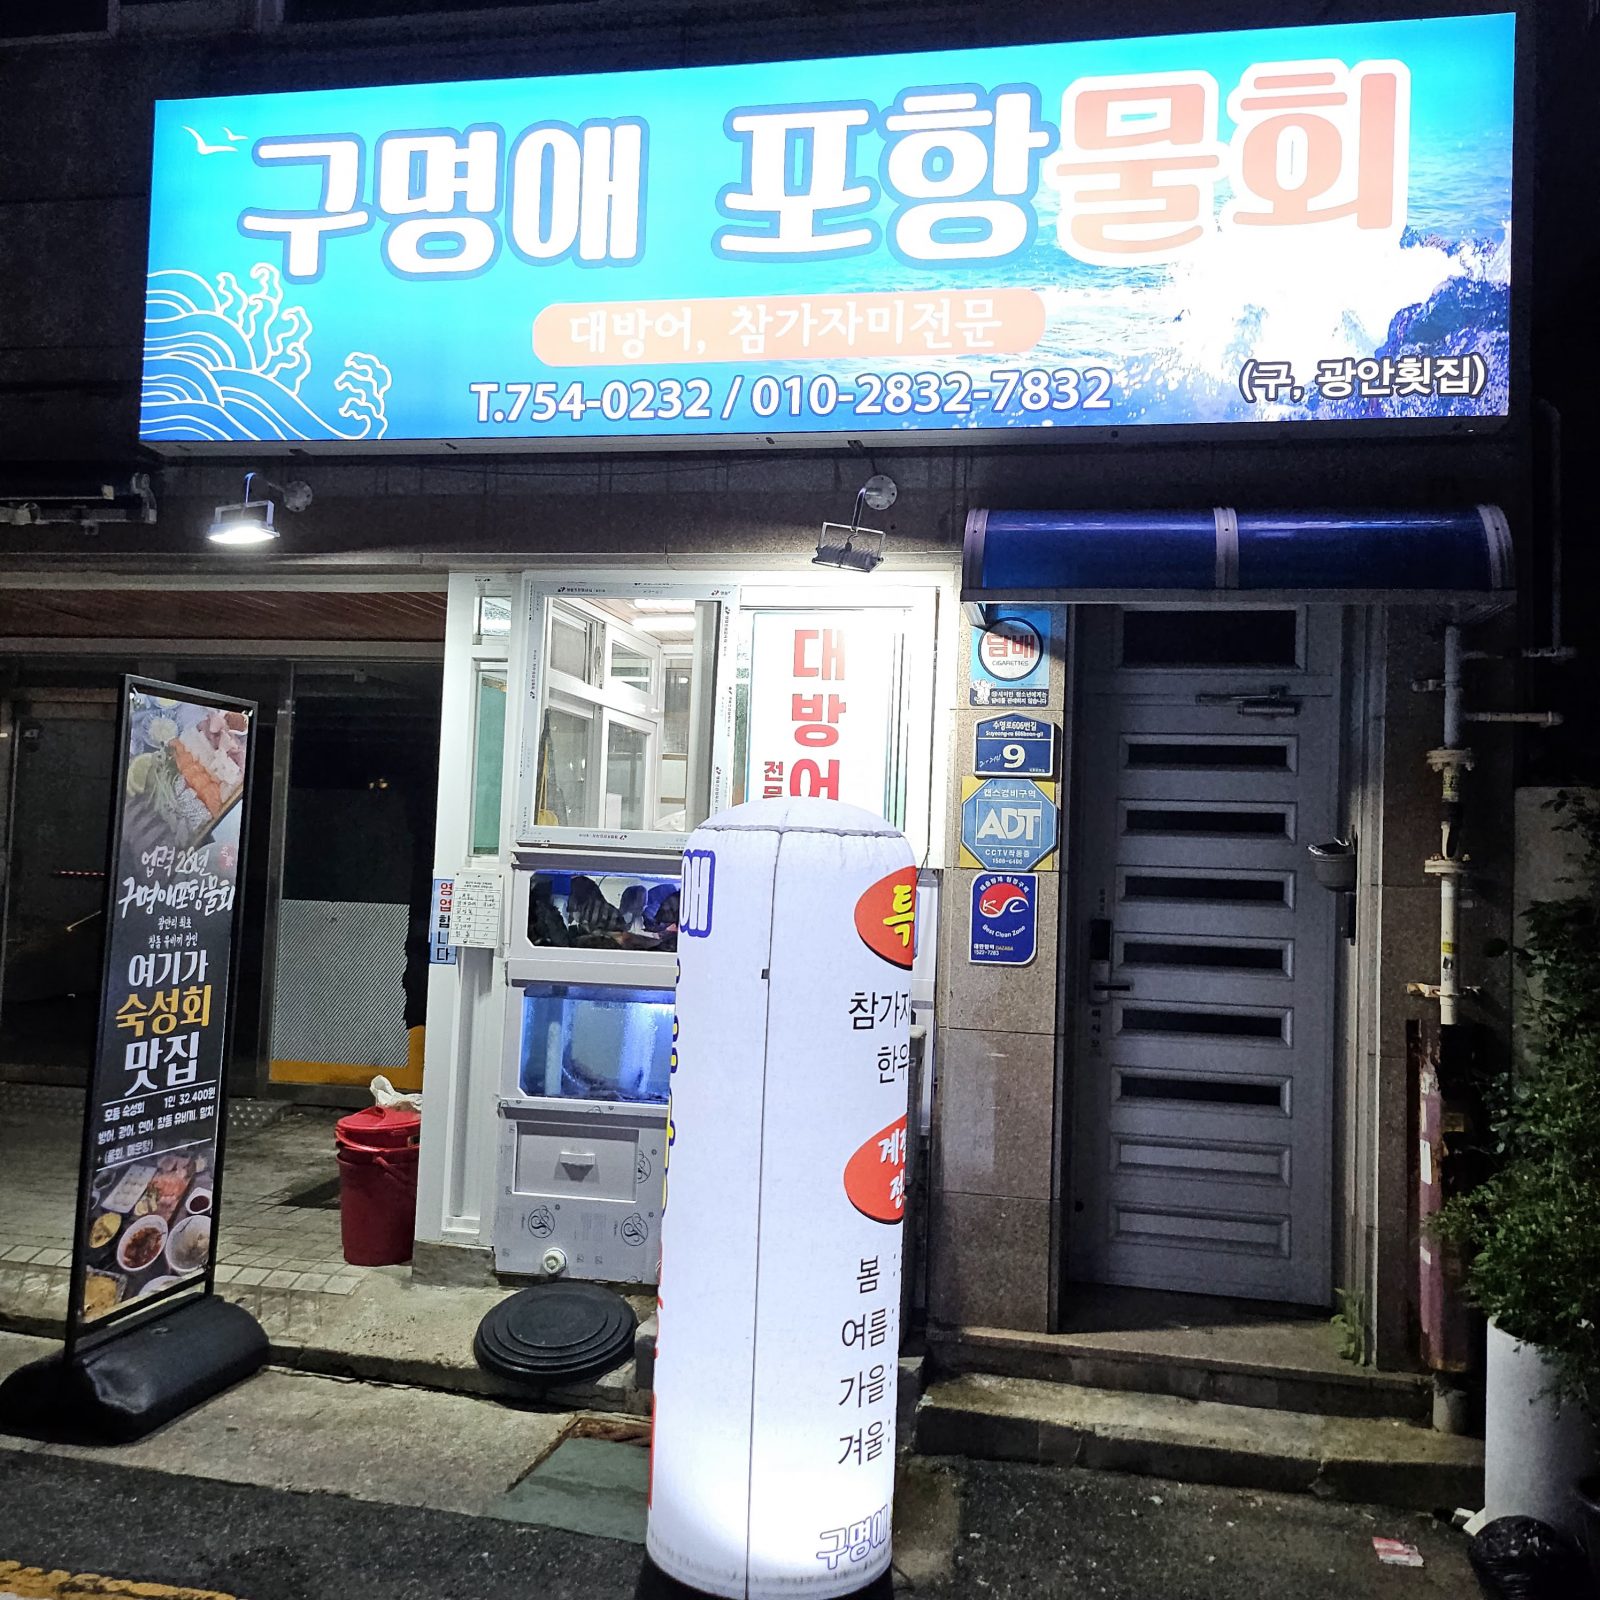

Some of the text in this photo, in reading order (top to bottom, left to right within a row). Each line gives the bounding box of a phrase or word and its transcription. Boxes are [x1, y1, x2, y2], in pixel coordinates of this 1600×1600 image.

[239, 117, 648, 282] 구명애
[569, 306, 706, 359] 대방어,
[470, 377, 712, 423] T.754-0232
[750, 367, 1113, 418] 010-2832-7832
[1239, 352, 1487, 403] (구, 광안횟집)
[987, 634, 1034, 658] 담배
[790, 629, 846, 801] 대방어
[1002, 744, 1025, 769] 9
[977, 807, 1041, 840] ADT
[883, 883, 915, 948] 특
[128, 949, 209, 988] 여기가
[115, 984, 212, 1037] 숙성회
[124, 1031, 200, 1097] 맛집
